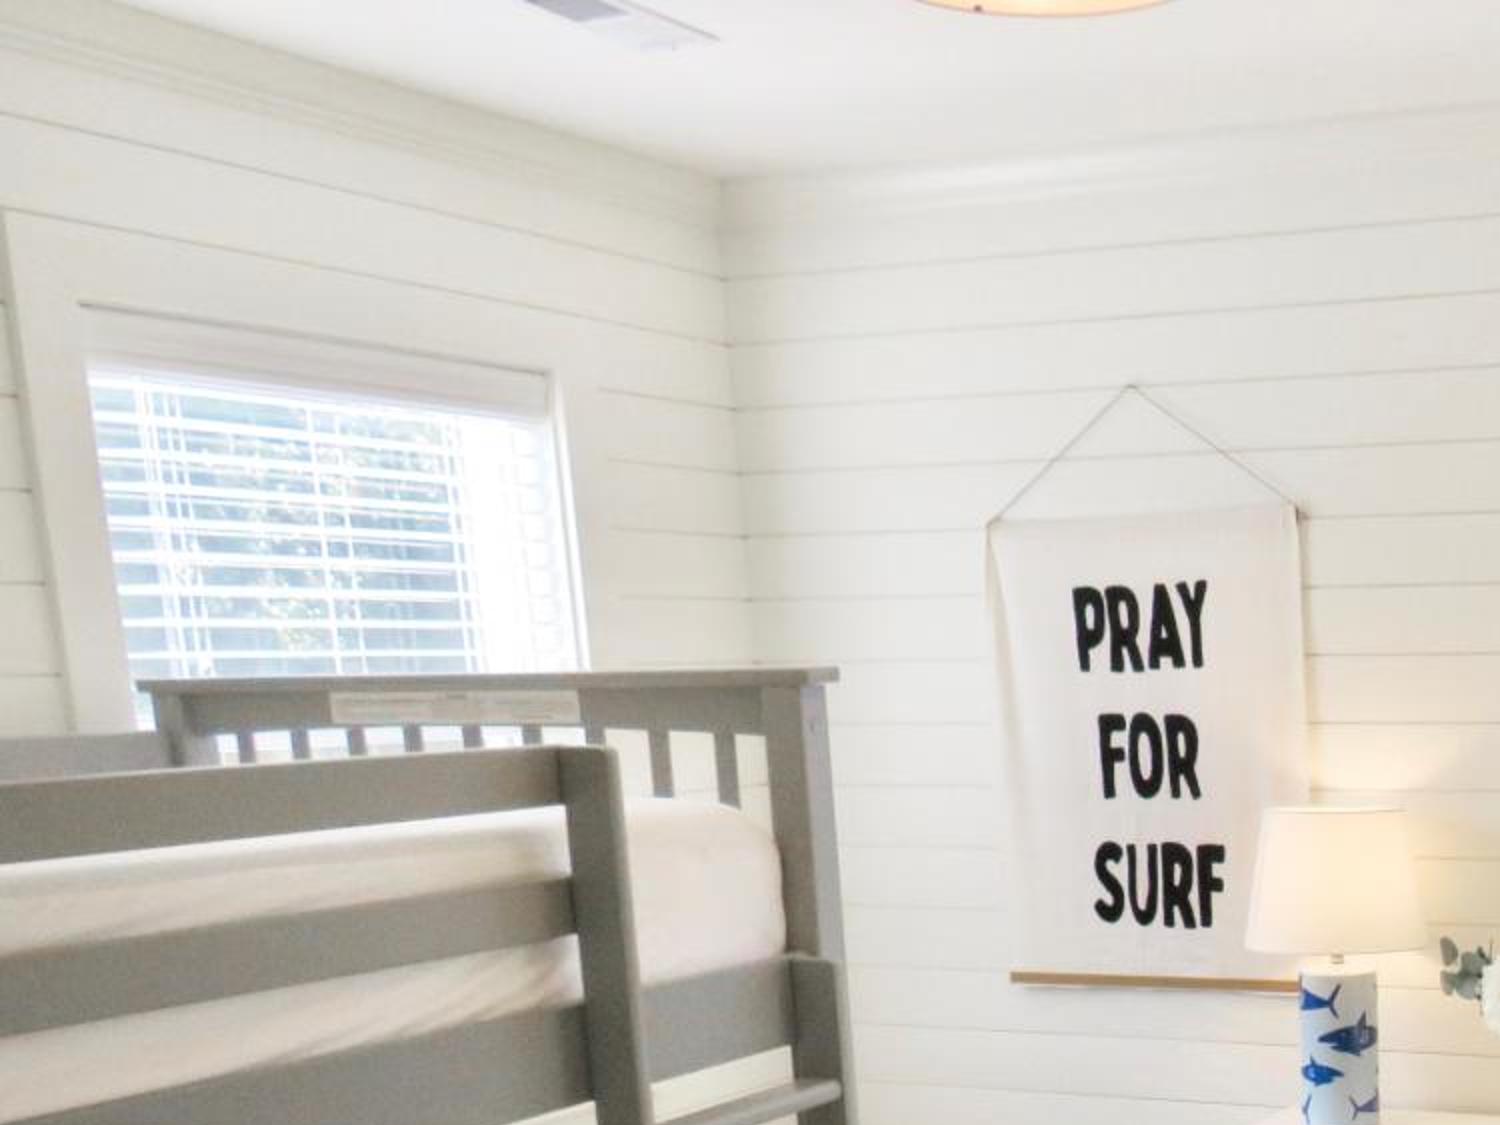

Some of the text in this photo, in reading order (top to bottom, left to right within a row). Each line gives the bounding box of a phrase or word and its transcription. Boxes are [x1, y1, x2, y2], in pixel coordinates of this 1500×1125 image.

[1072, 579, 1208, 674] PRAY
[1097, 712, 1202, 801] FOR
[1093, 841, 1226, 930] SURF
